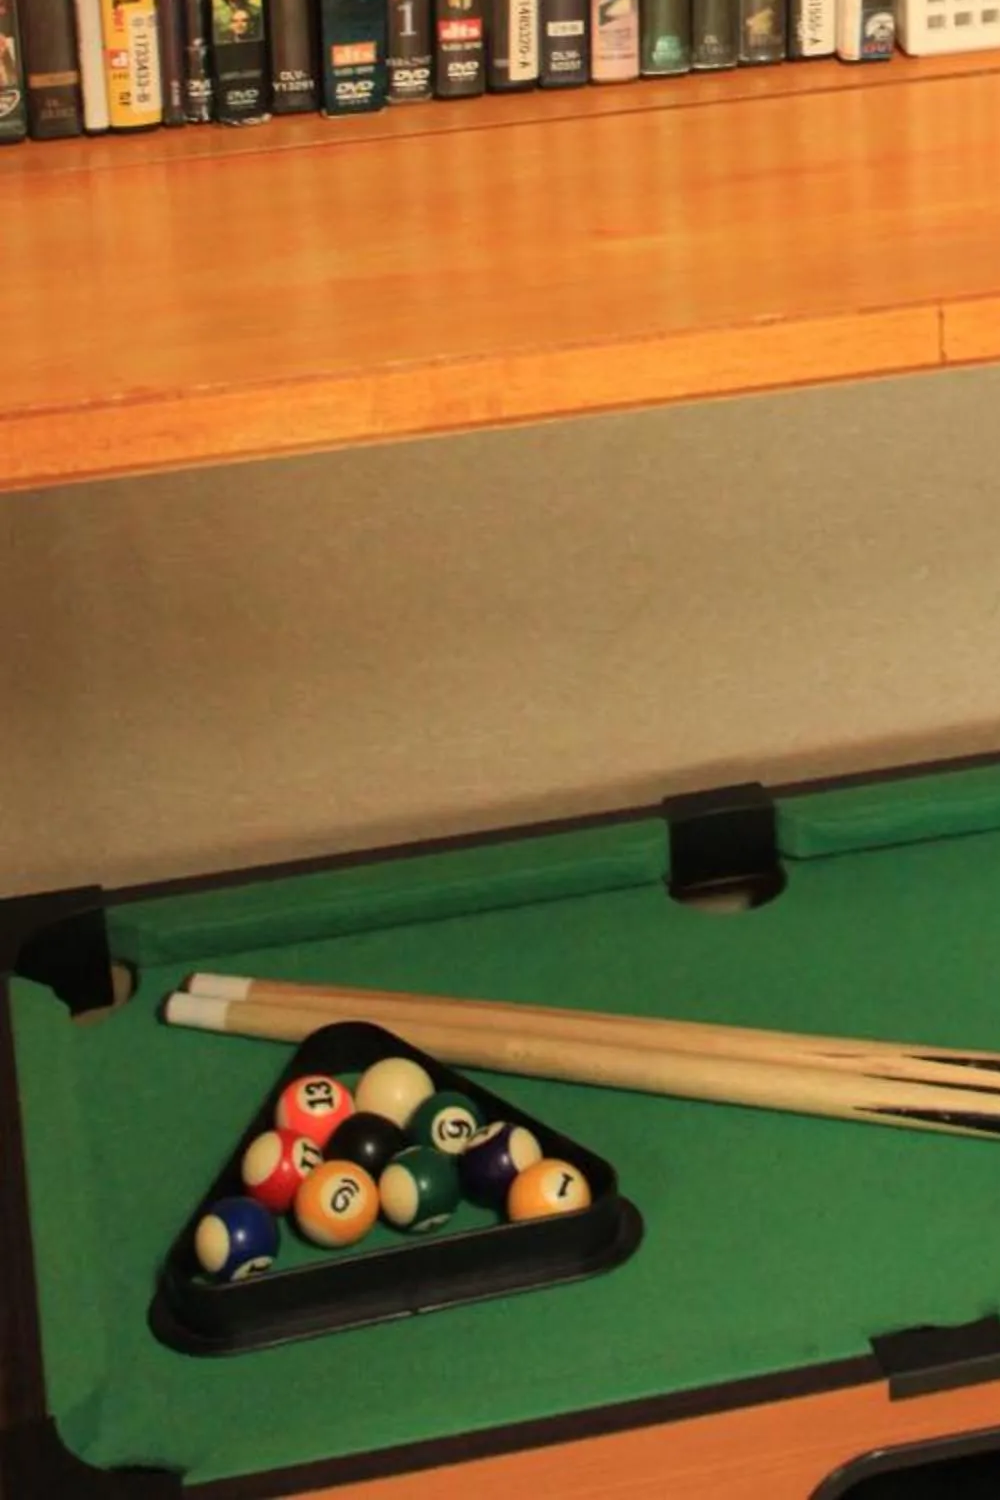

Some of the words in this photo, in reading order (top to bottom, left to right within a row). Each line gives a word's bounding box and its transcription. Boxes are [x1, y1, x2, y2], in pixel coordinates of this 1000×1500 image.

[399, 3, 417, 36] 1
[305, 1079, 335, 1110] 13
[556, 1173, 575, 1198] 1
